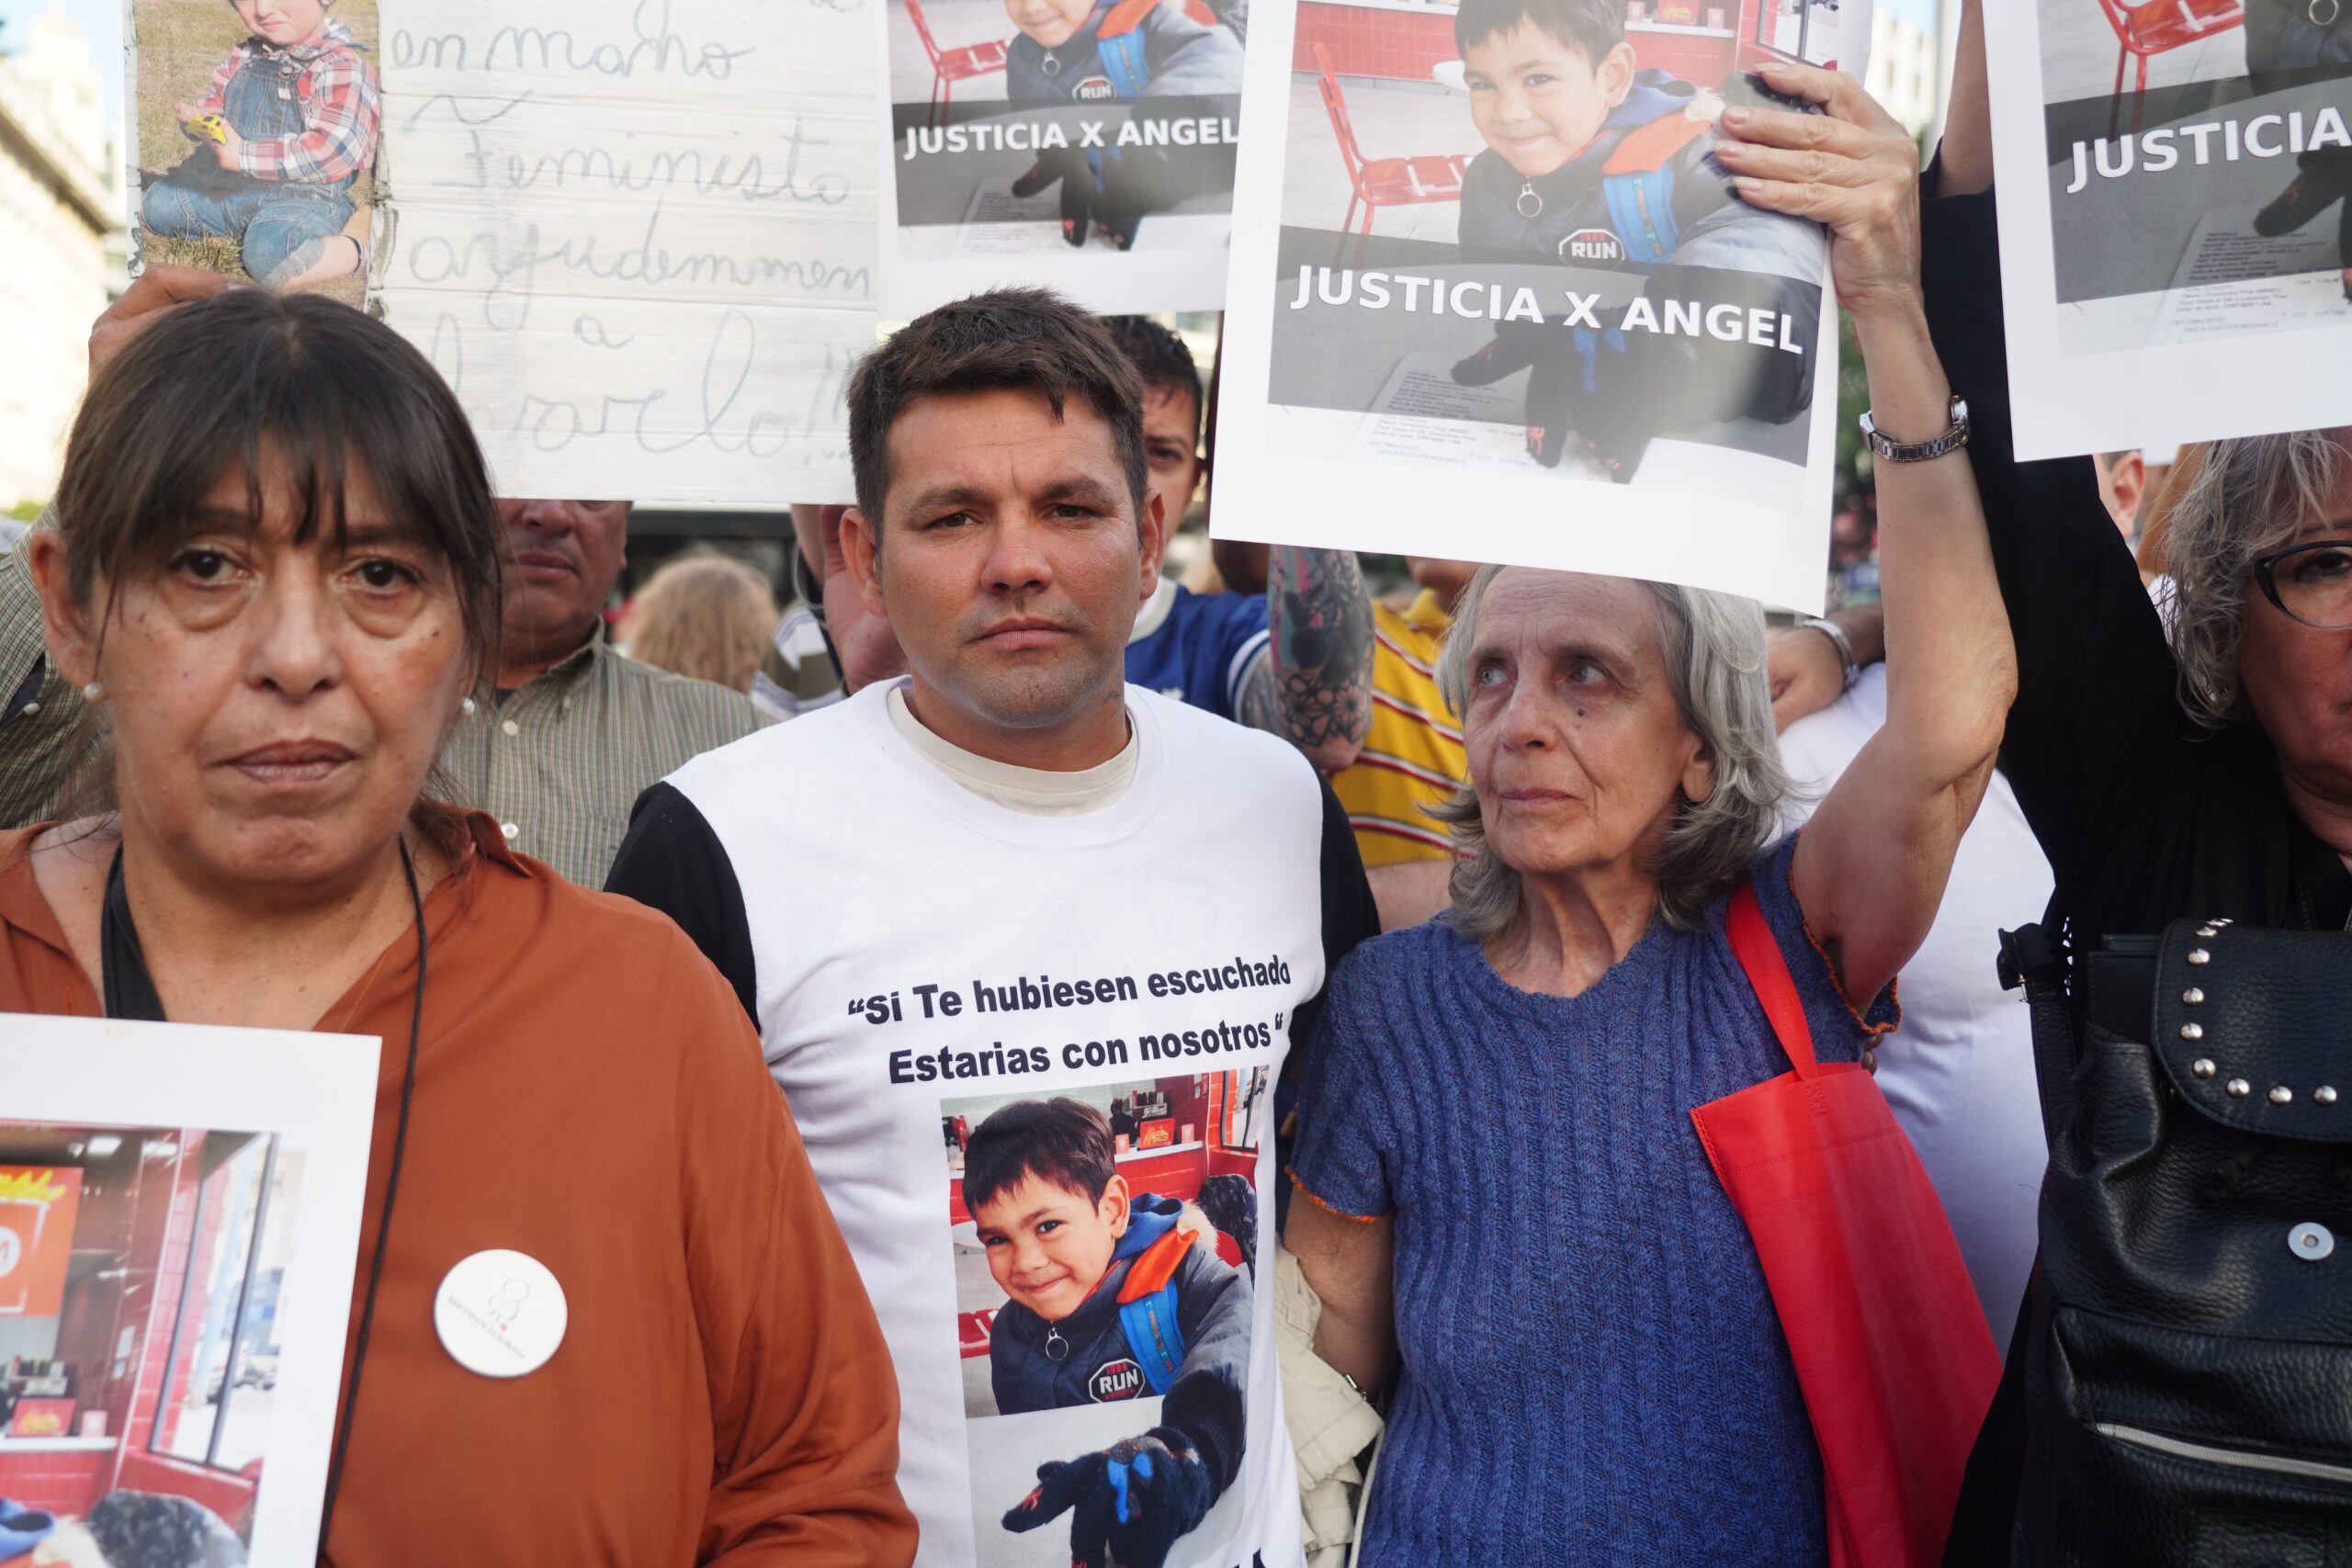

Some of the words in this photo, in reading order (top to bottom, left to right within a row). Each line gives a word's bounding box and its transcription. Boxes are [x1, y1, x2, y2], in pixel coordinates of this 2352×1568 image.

[389, 29, 467, 71] en
[903, 121, 1068, 162] JUSTICIA
[1080, 121, 1105, 148] X
[1116, 117, 1238, 147] ANGEL
[2065, 106, 2352, 194] JUSTICIA
[1571, 241, 1617, 259] RUN
[574, 313, 634, 350] a
[1289, 265, 1545, 325] JUSTICIA
[1562, 291, 1602, 329] X
[1619, 295, 1804, 355] ANGEL
[912, 983, 964, 1020] Te
[971, 974, 1139, 1013] hubiesen
[1146, 953, 1291, 998] escuchado
[888, 1042, 1051, 1085] Estarias
[1061, 1038, 1129, 1070] con
[1099, 1368, 1139, 1393] RUN
